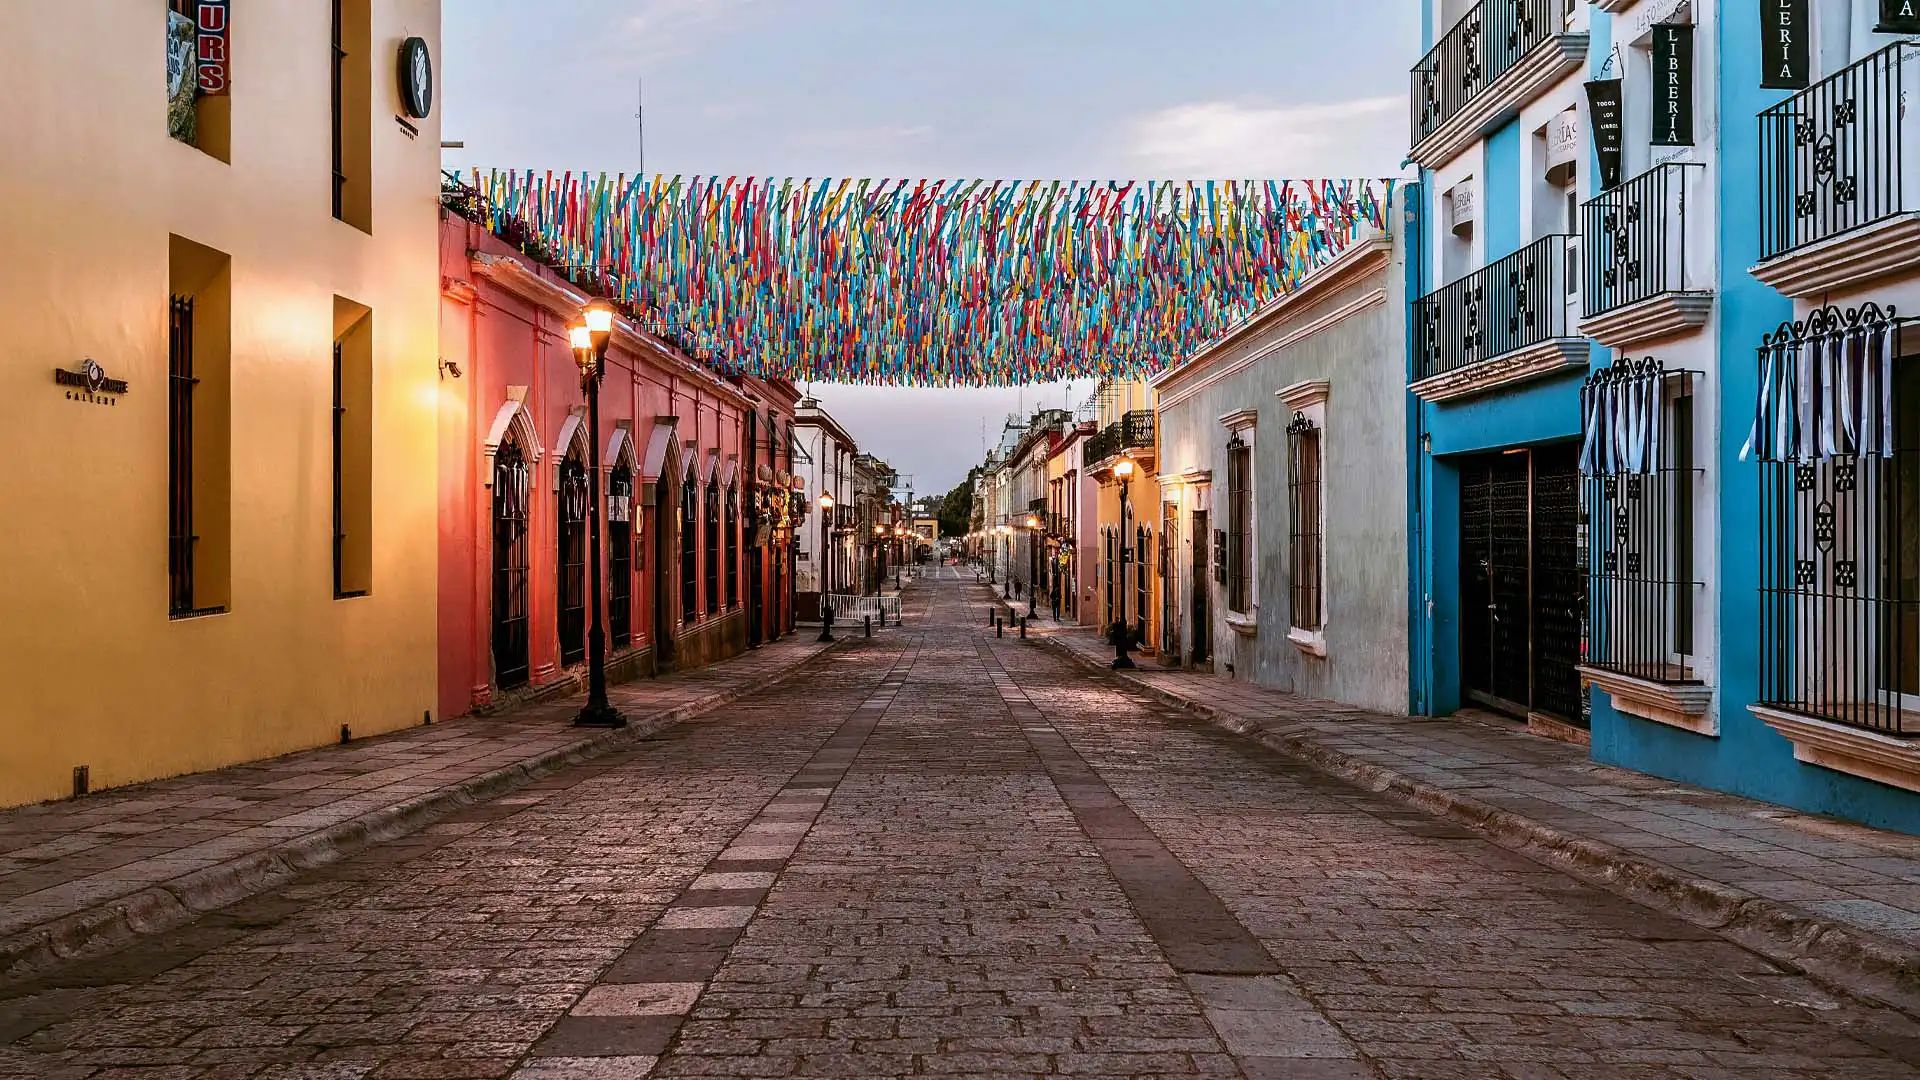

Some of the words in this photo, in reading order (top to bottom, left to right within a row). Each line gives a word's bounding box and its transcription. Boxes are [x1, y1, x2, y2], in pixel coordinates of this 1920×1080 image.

[198, 0, 225, 91] URS
[1667, 29, 1679, 142] LIBRERÍA
[66, 391, 116, 406] GALLERY
